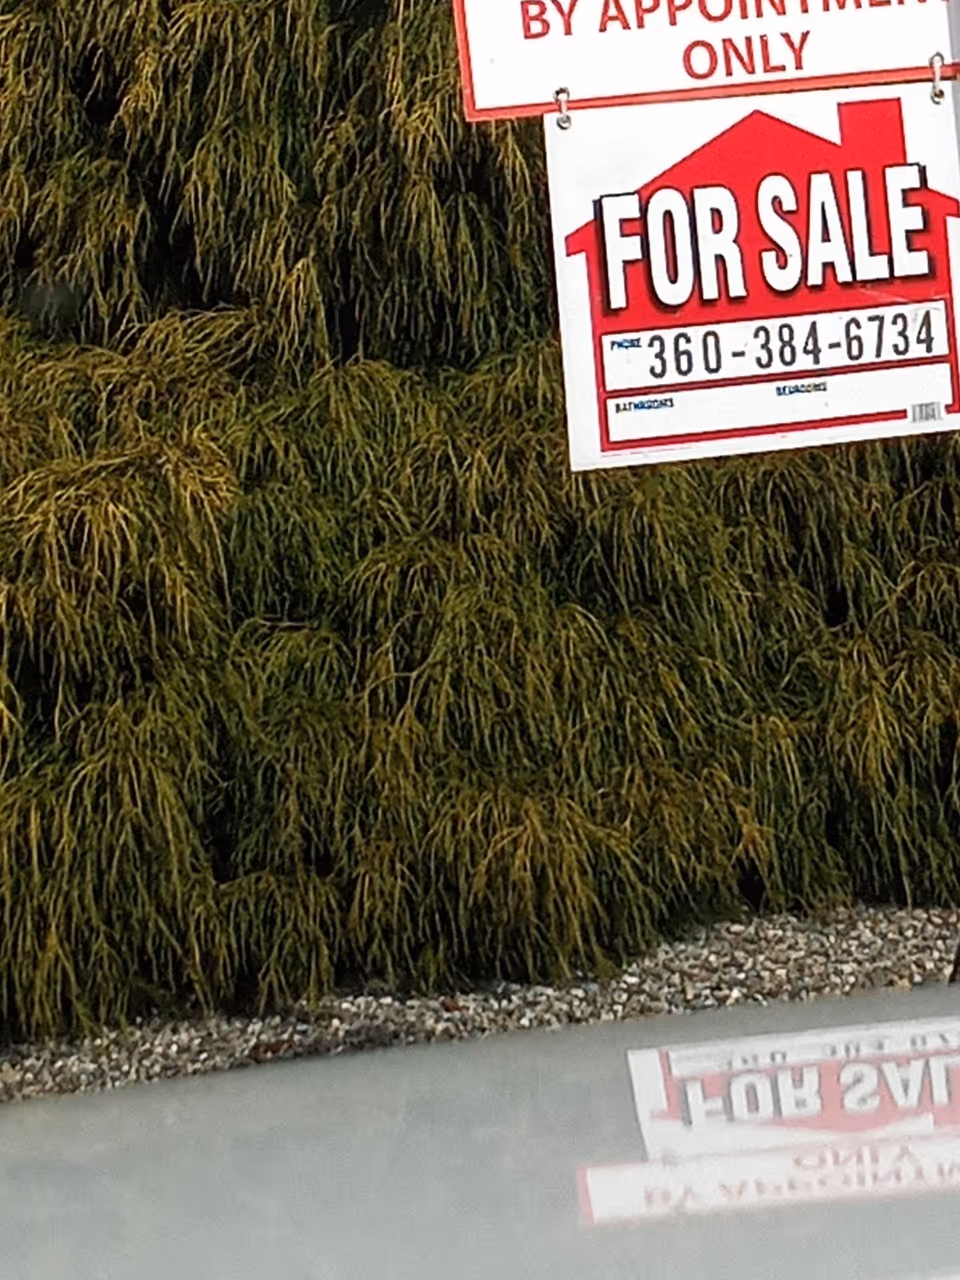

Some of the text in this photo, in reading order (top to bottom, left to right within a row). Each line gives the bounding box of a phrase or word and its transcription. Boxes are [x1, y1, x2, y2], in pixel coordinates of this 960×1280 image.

[682, 30, 811, 80] ONLY
[594, 163, 931, 314] FOR SALE
[648, 310, 935, 378] 360-384-6734
